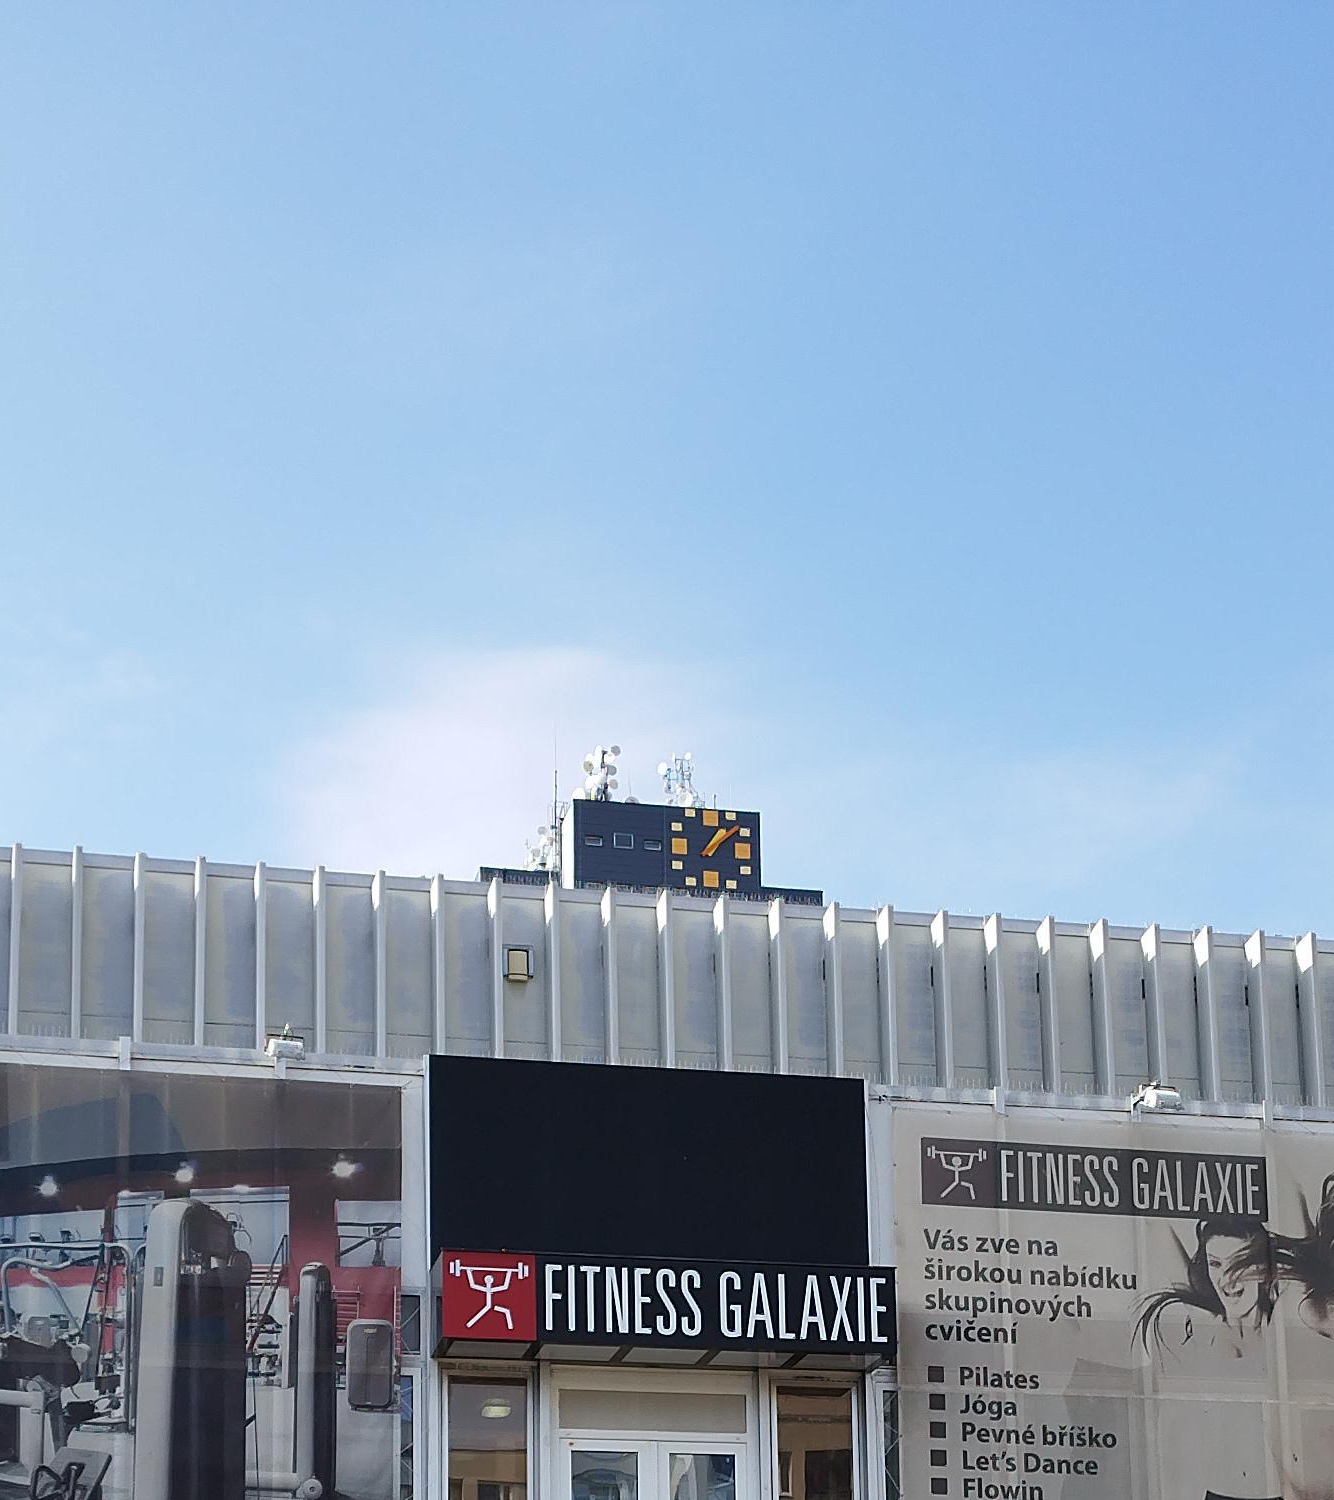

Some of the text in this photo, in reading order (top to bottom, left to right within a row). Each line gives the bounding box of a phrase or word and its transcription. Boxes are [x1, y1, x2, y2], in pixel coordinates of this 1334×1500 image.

[1000, 1150, 1260, 1215] FITNESS GALAXIE
[924, 1228, 1058, 1257] Vás zve na
[924, 1258, 1137, 1290] širokou nabídku
[544, 1263, 888, 1343] FITNESS GALAXIE
[924, 1288, 1092, 1322] skupinových
[925, 1319, 1019, 1344] cvičení
[959, 1366, 1040, 1390] Pilates
[959, 1394, 1017, 1421] Jóga
[961, 1422, 1117, 1448] Pevné bříško
[1023, 1452, 1099, 1475] Dance
[963, 1477, 1044, 1500] Flowin
